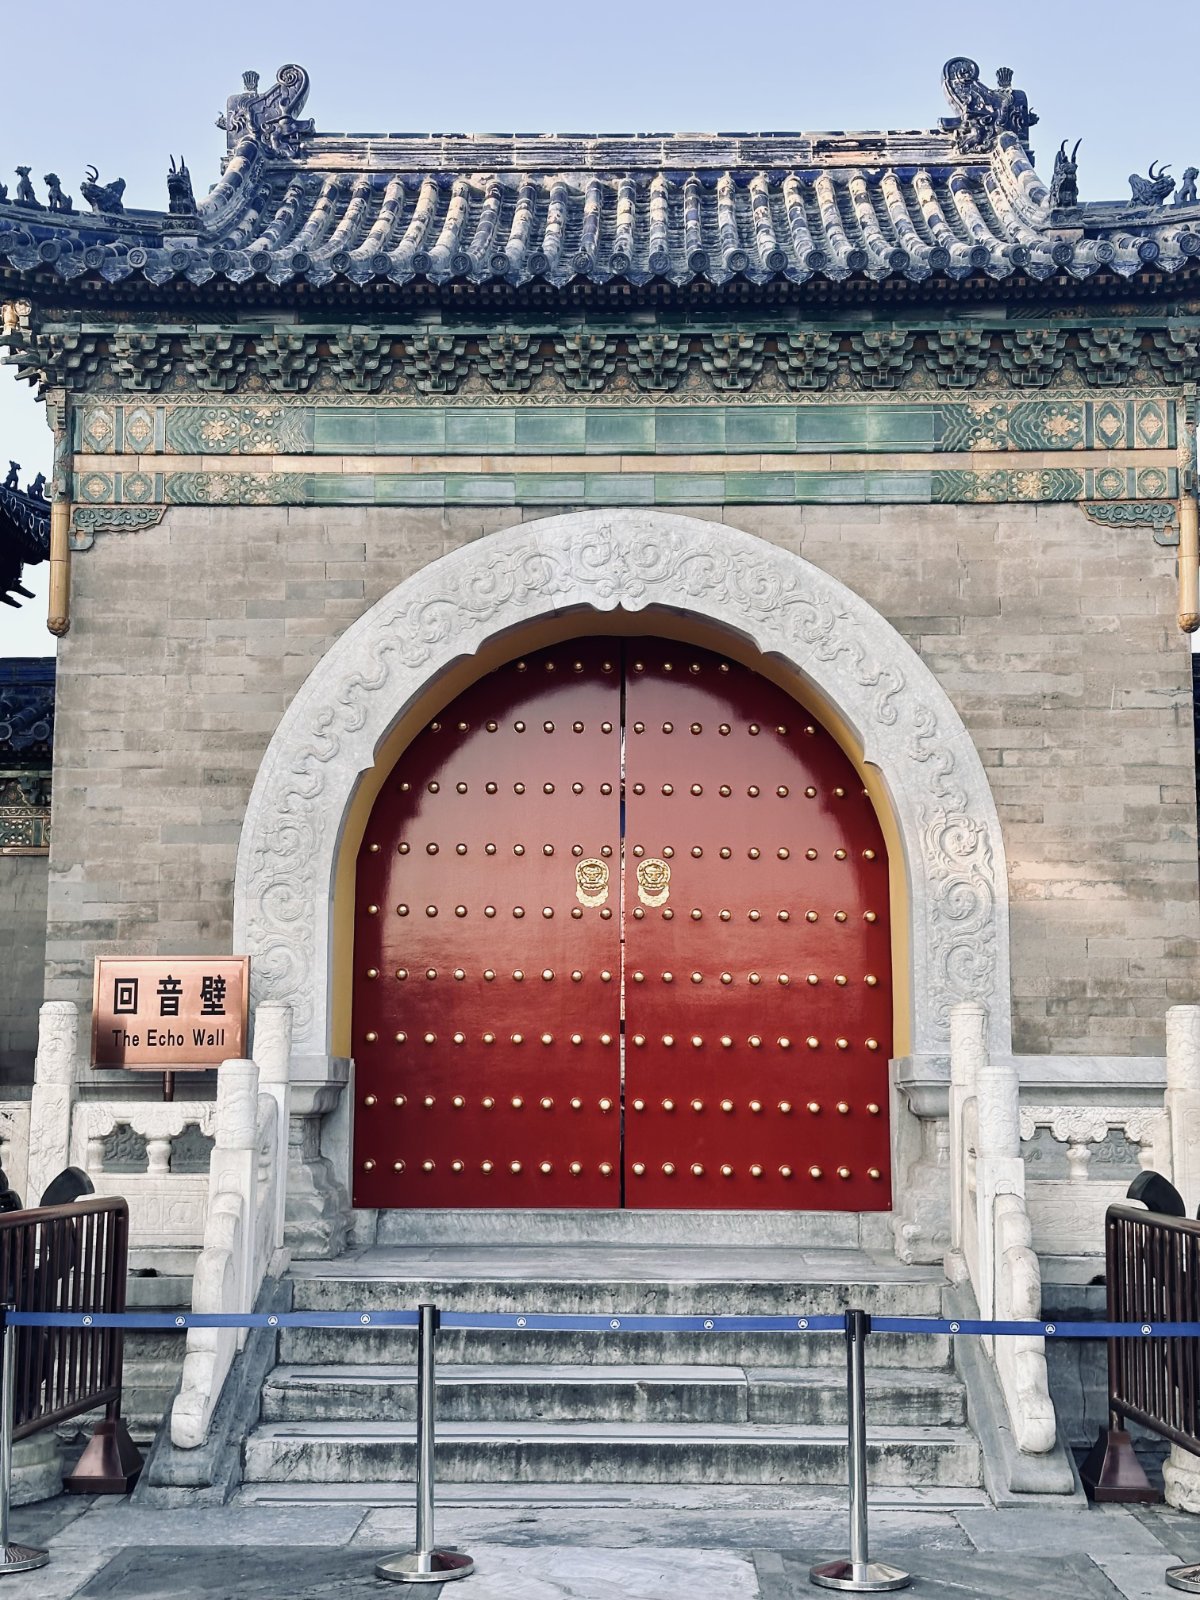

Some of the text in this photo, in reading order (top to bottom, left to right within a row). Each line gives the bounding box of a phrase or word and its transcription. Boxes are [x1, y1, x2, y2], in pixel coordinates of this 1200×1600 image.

[113, 974, 226, 1016] 回音壁
[112, 1029, 225, 1047] The Echo Wall
